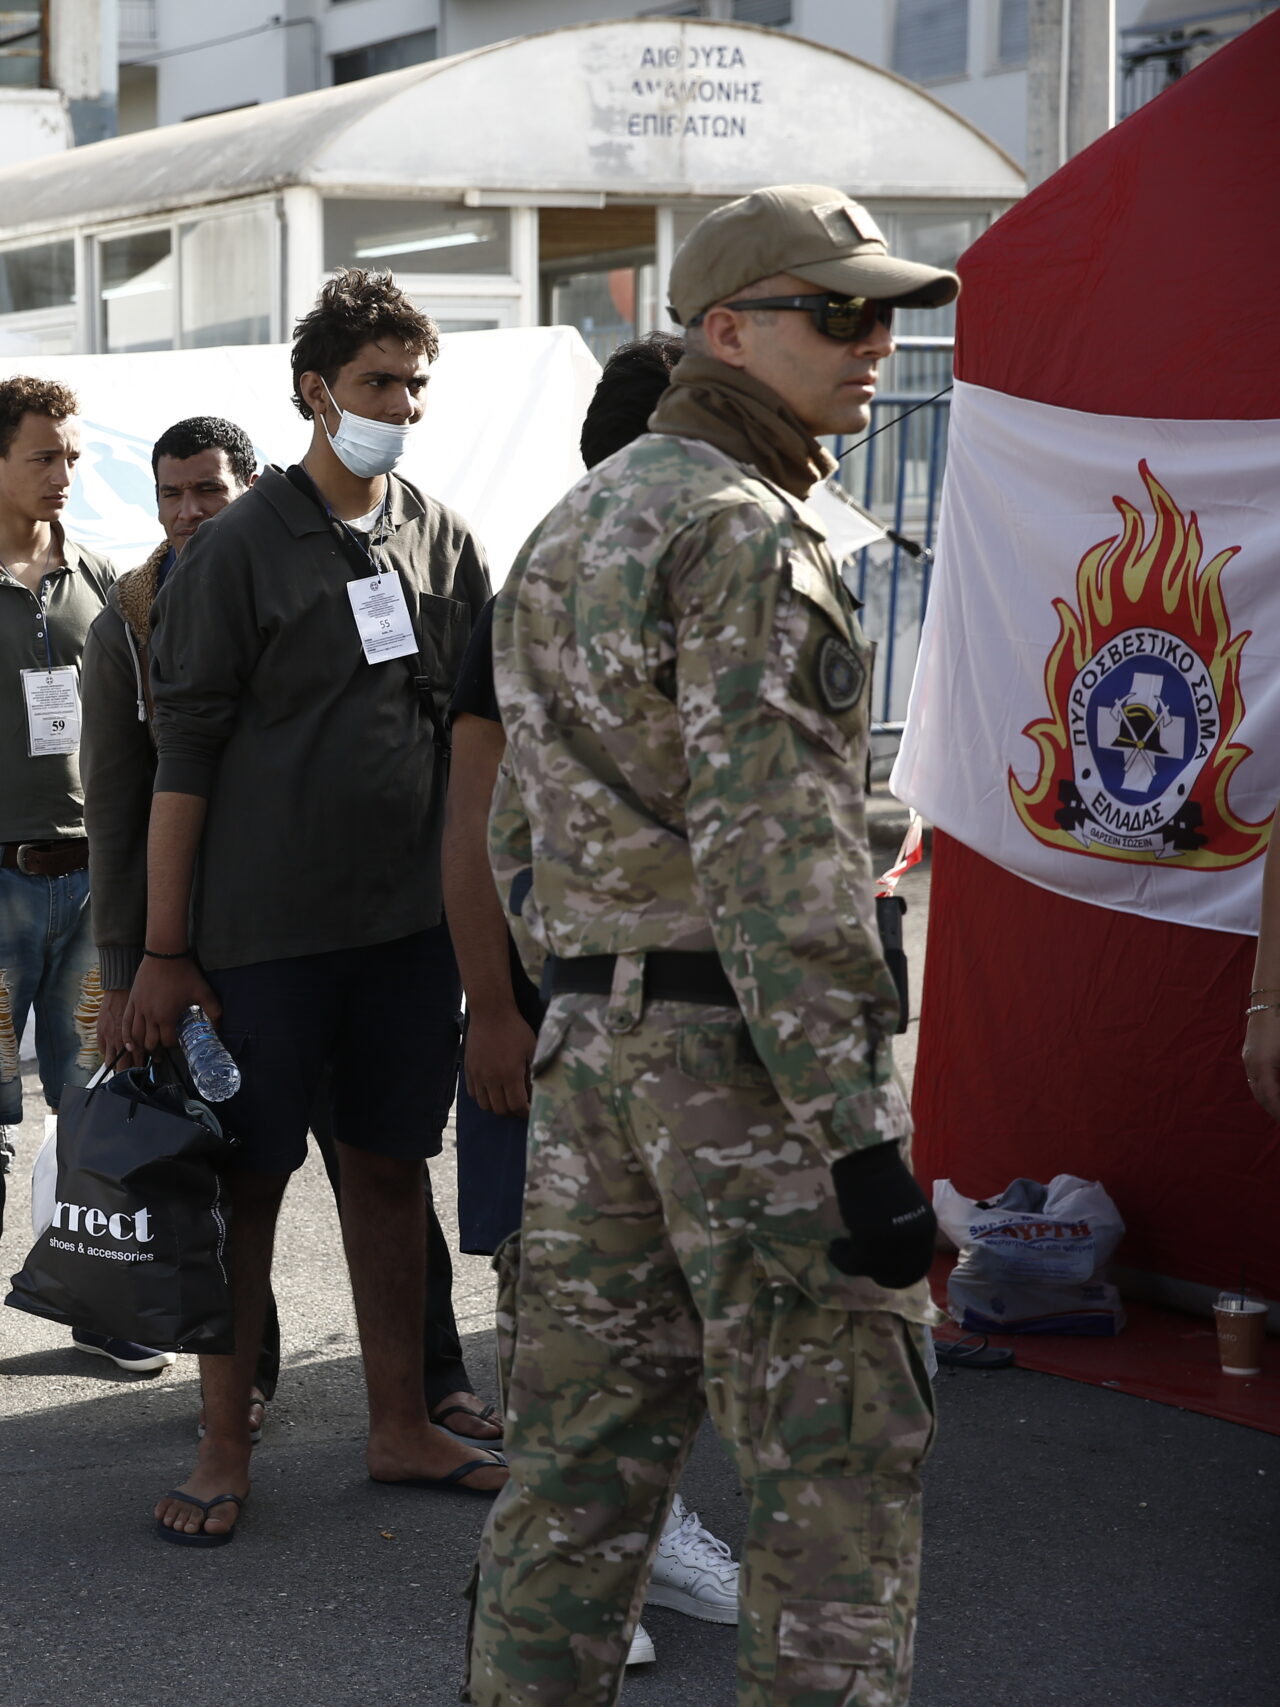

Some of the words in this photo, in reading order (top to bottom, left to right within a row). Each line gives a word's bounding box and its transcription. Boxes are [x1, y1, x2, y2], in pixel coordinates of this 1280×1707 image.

[379, 619, 391, 629] 55
[1071, 632, 1195, 747] ΠΥΡΟΣΒΕΣΤΙΚΟ
[1191, 674, 1217, 761] ΣΩΜΑ
[52, 720, 65, 732] 59
[1091, 791, 1164, 832] ΕΛΛΑΔΑΣ
[49, 1237, 75, 1252] shoes
[77, 1242, 85, 1253] &
[87, 1245, 154, 1262] accessories
